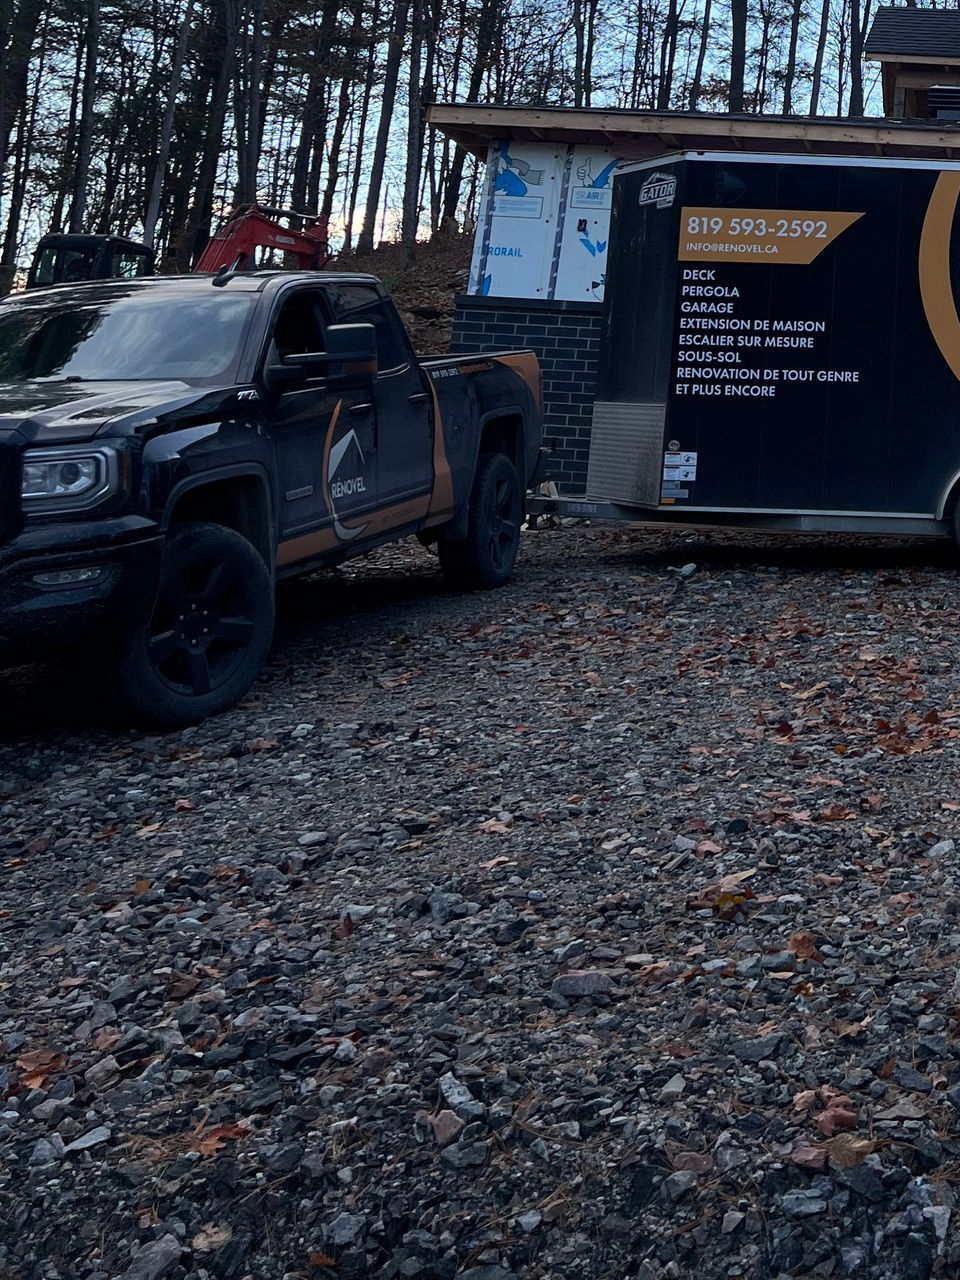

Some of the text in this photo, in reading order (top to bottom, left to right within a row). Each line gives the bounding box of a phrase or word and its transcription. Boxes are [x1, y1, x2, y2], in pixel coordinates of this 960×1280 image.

[641, 182, 675, 201] GATOR
[687, 216, 828, 239] 819 593-2592
[686, 242, 779, 254] INFO@RENOVEL.CA
[683, 269, 716, 281] DECK
[682, 285, 740, 297] PERGOLA
[680, 302, 734, 313] GARAGE
[679, 318, 826, 332] EXTENSION DE MAISON
[678, 334, 814, 348] ESCALIER SUR MESURE
[677, 351, 742, 363] SOUS-SOL
[676, 367, 859, 382] RENOVATION DE TOUT GENRE
[675, 384, 776, 397] ET PLUS ENCORE
[332, 477, 366, 499] RÉNOVEL
